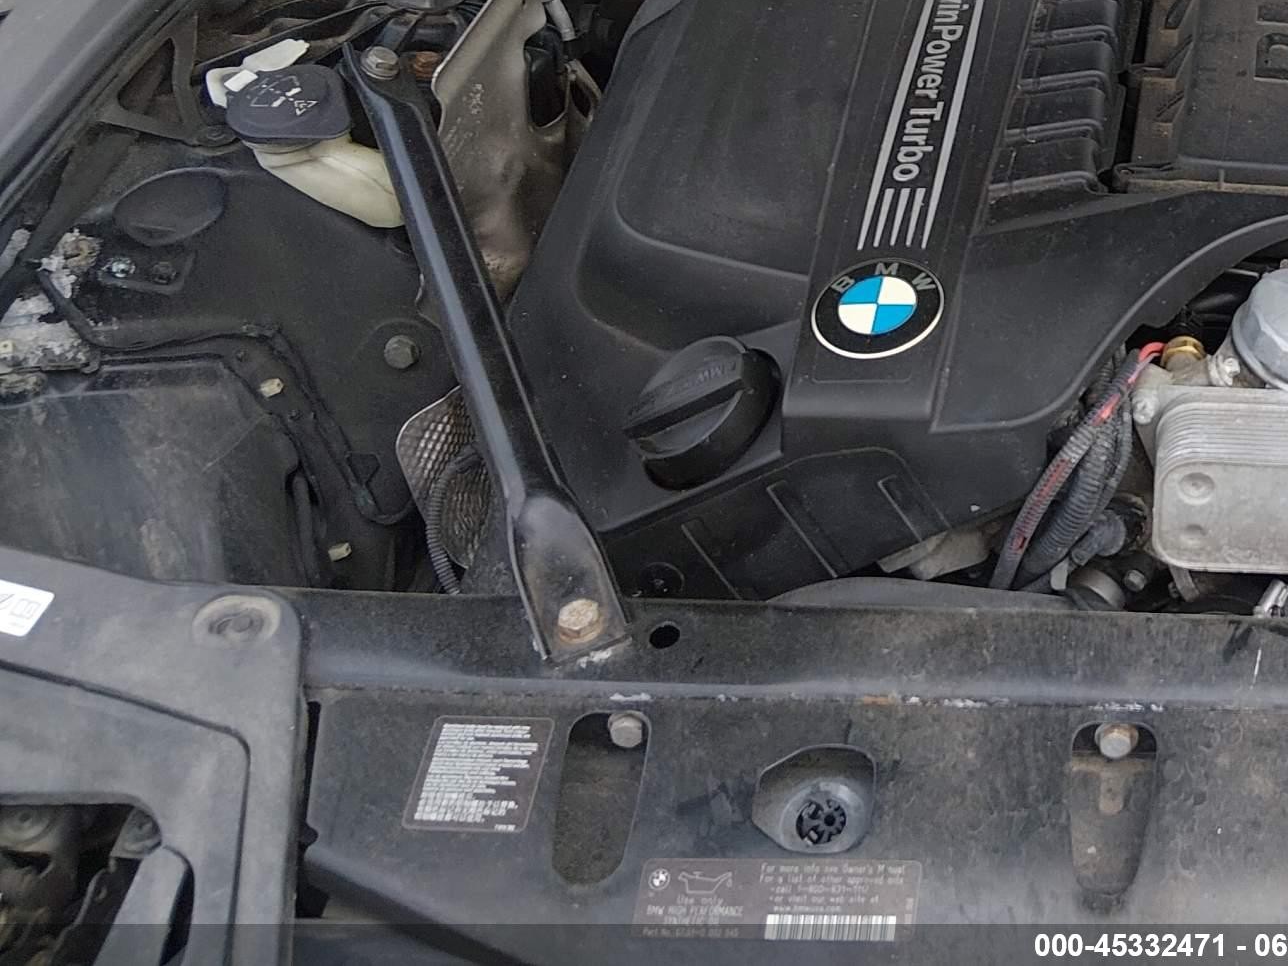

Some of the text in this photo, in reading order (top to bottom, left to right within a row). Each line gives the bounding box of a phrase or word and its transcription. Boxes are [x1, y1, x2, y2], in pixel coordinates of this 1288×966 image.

[892, 100, 944, 182] Turbo
[830, 262, 936, 294] BMW
[760, 873, 774, 883] For
[761, 862, 775, 873] For
[779, 865, 799, 873] more
[803, 862, 820, 873] info
